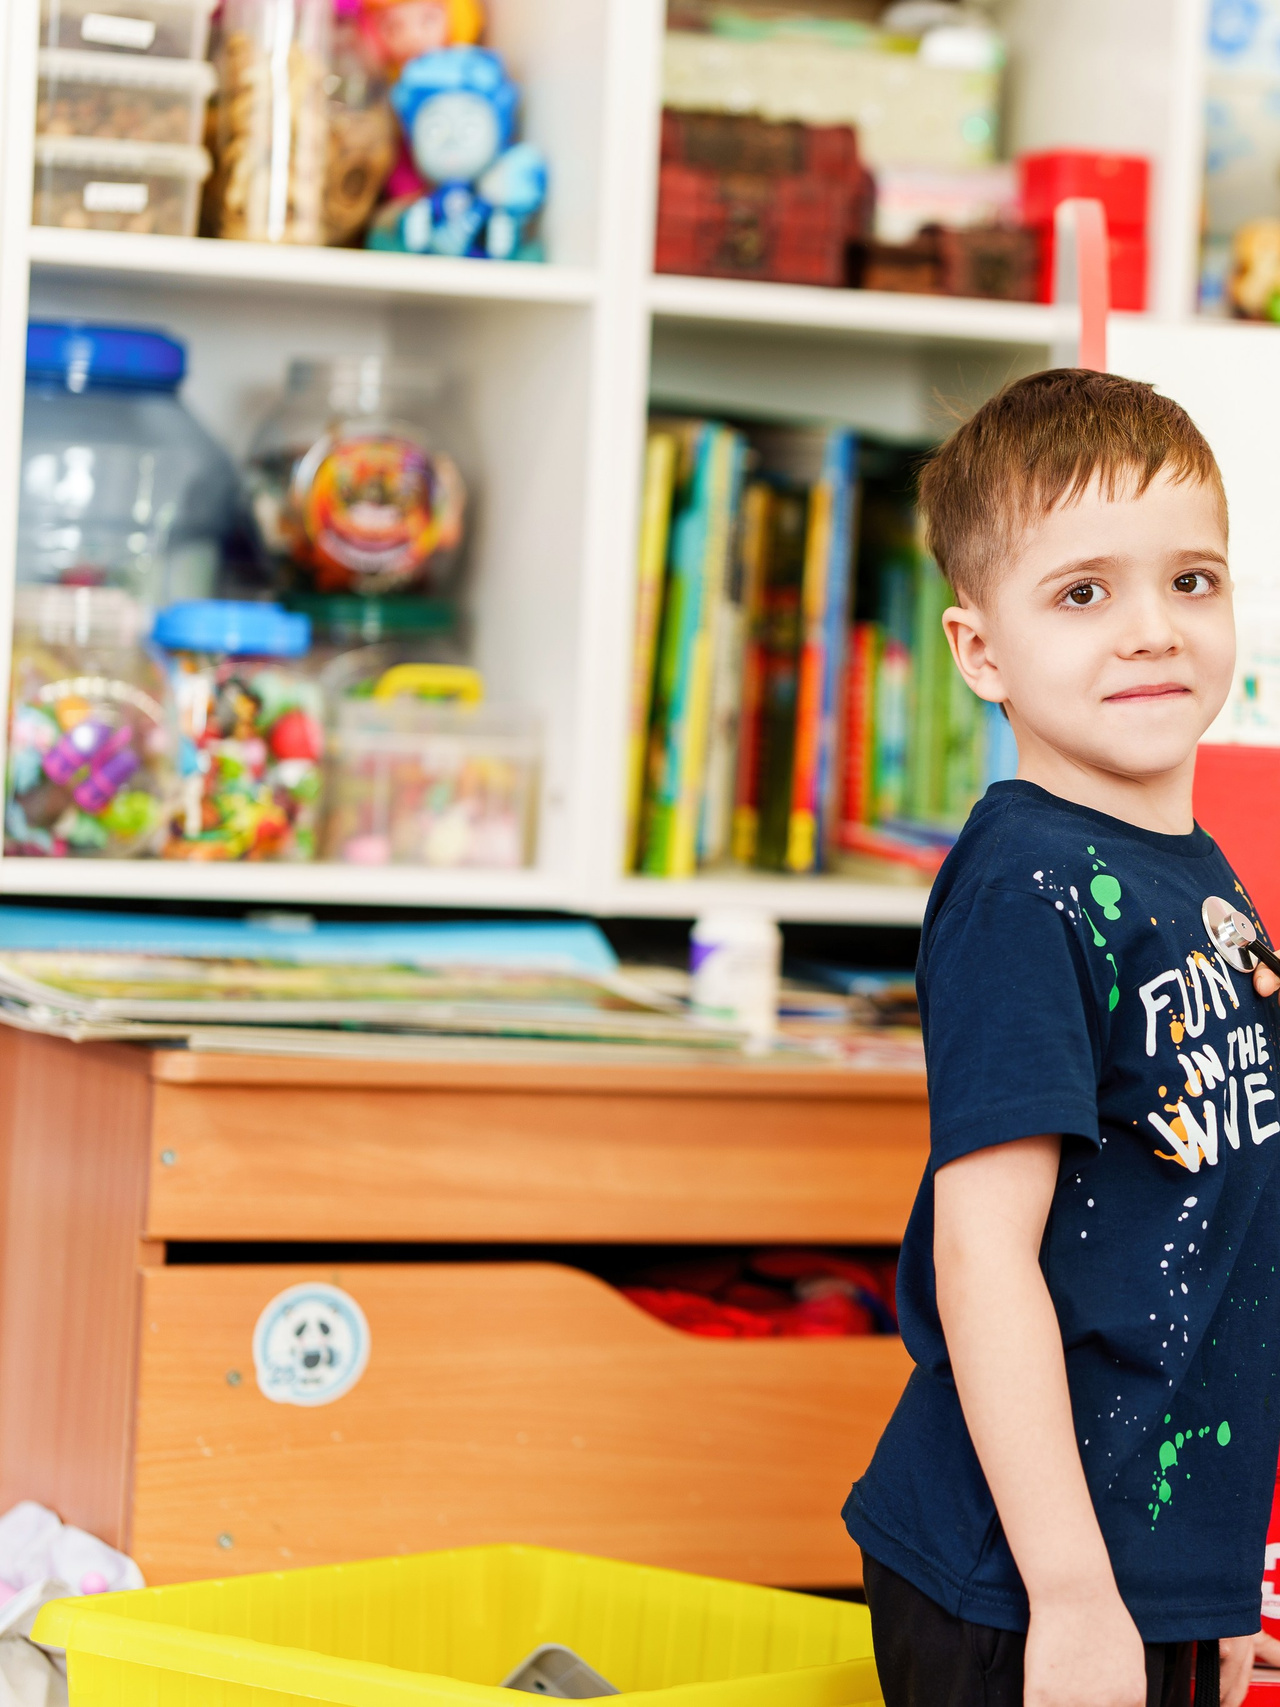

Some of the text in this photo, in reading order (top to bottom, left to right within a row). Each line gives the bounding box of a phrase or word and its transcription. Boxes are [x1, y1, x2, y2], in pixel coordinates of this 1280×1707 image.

[1139, 952, 1240, 1057] FUN
[1177, 1023, 1270, 1094] IN THE
